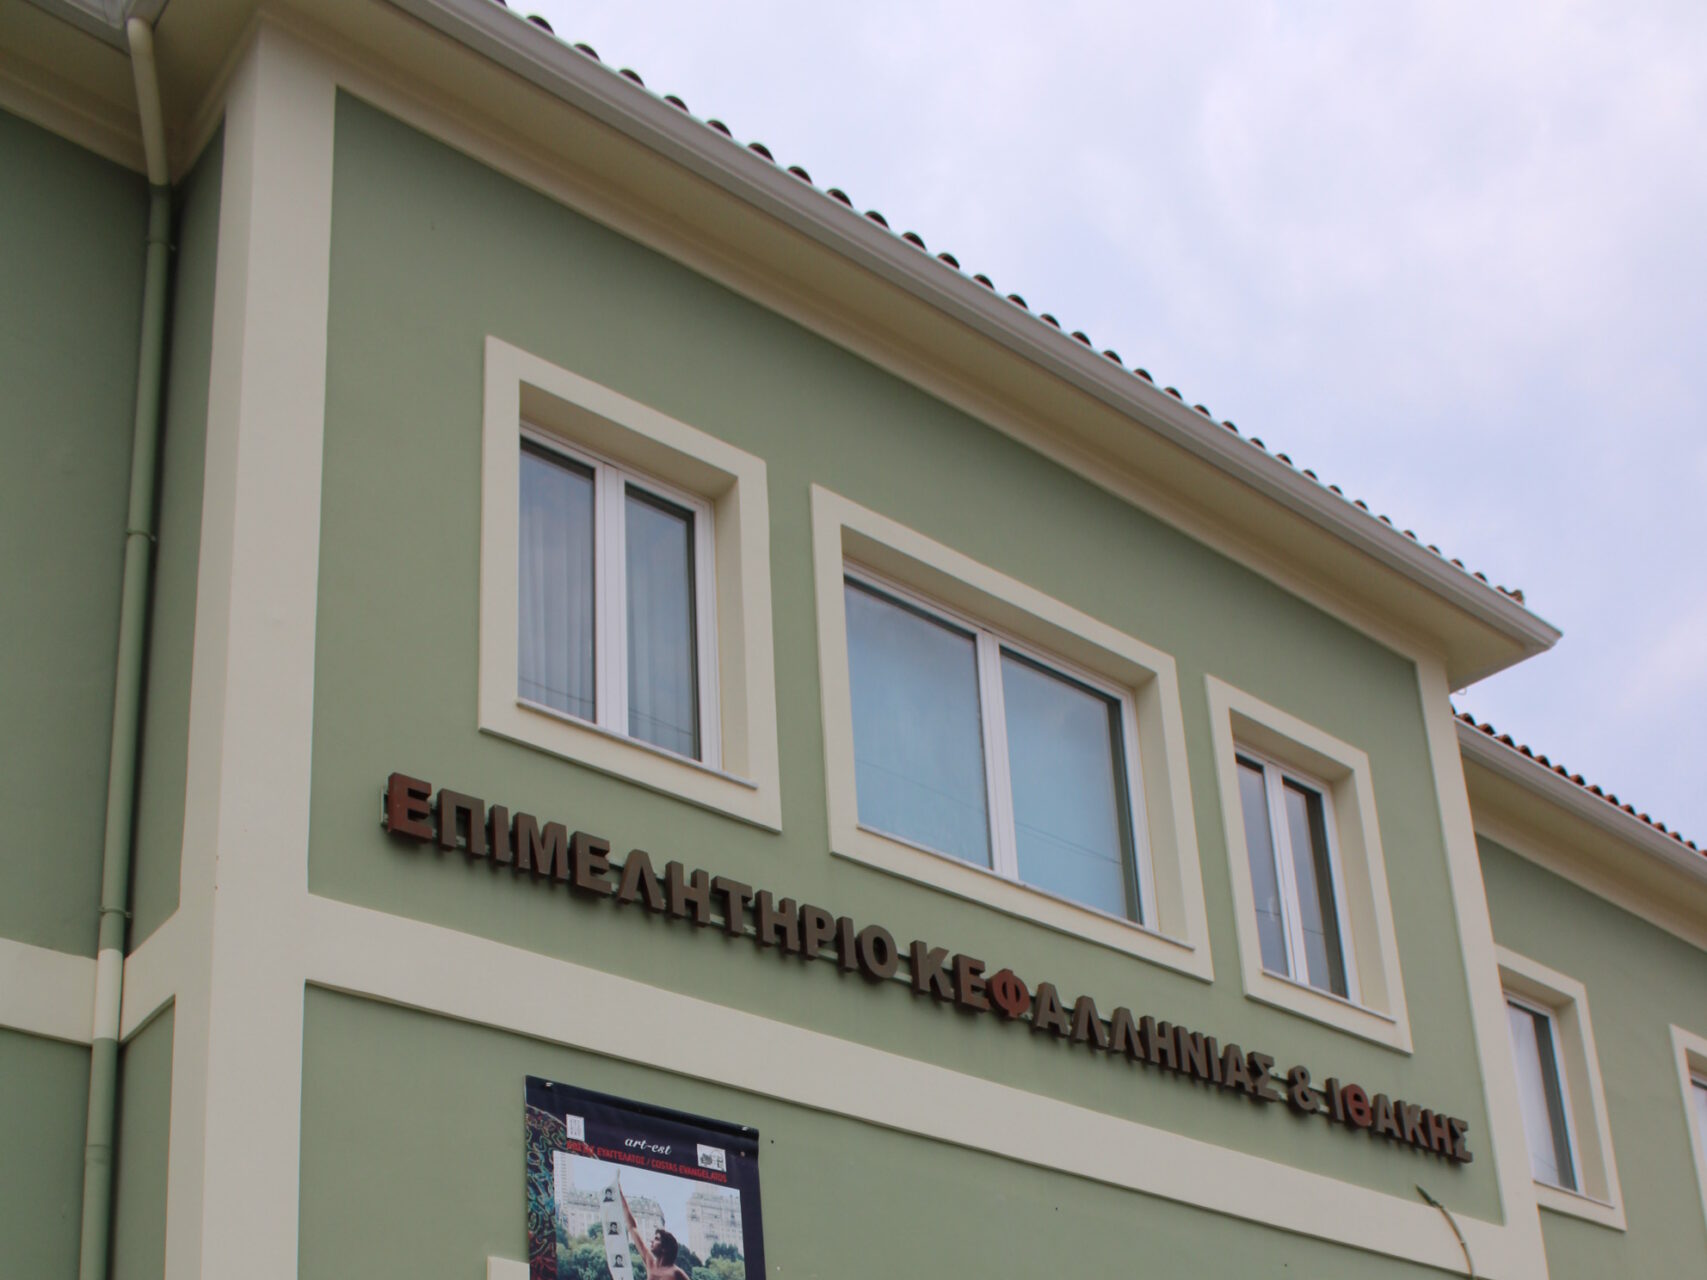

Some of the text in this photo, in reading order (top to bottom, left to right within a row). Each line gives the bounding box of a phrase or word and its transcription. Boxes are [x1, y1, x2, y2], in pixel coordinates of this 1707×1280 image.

[386, 771, 1474, 1163] ΕΠΙΜΕΛΗΤΗΡΙΟ ΚΕΦΑΛΛΗΝΙΑΣ & ΙΘΑΚΗΣ
[624, 1136, 673, 1155] art-est
